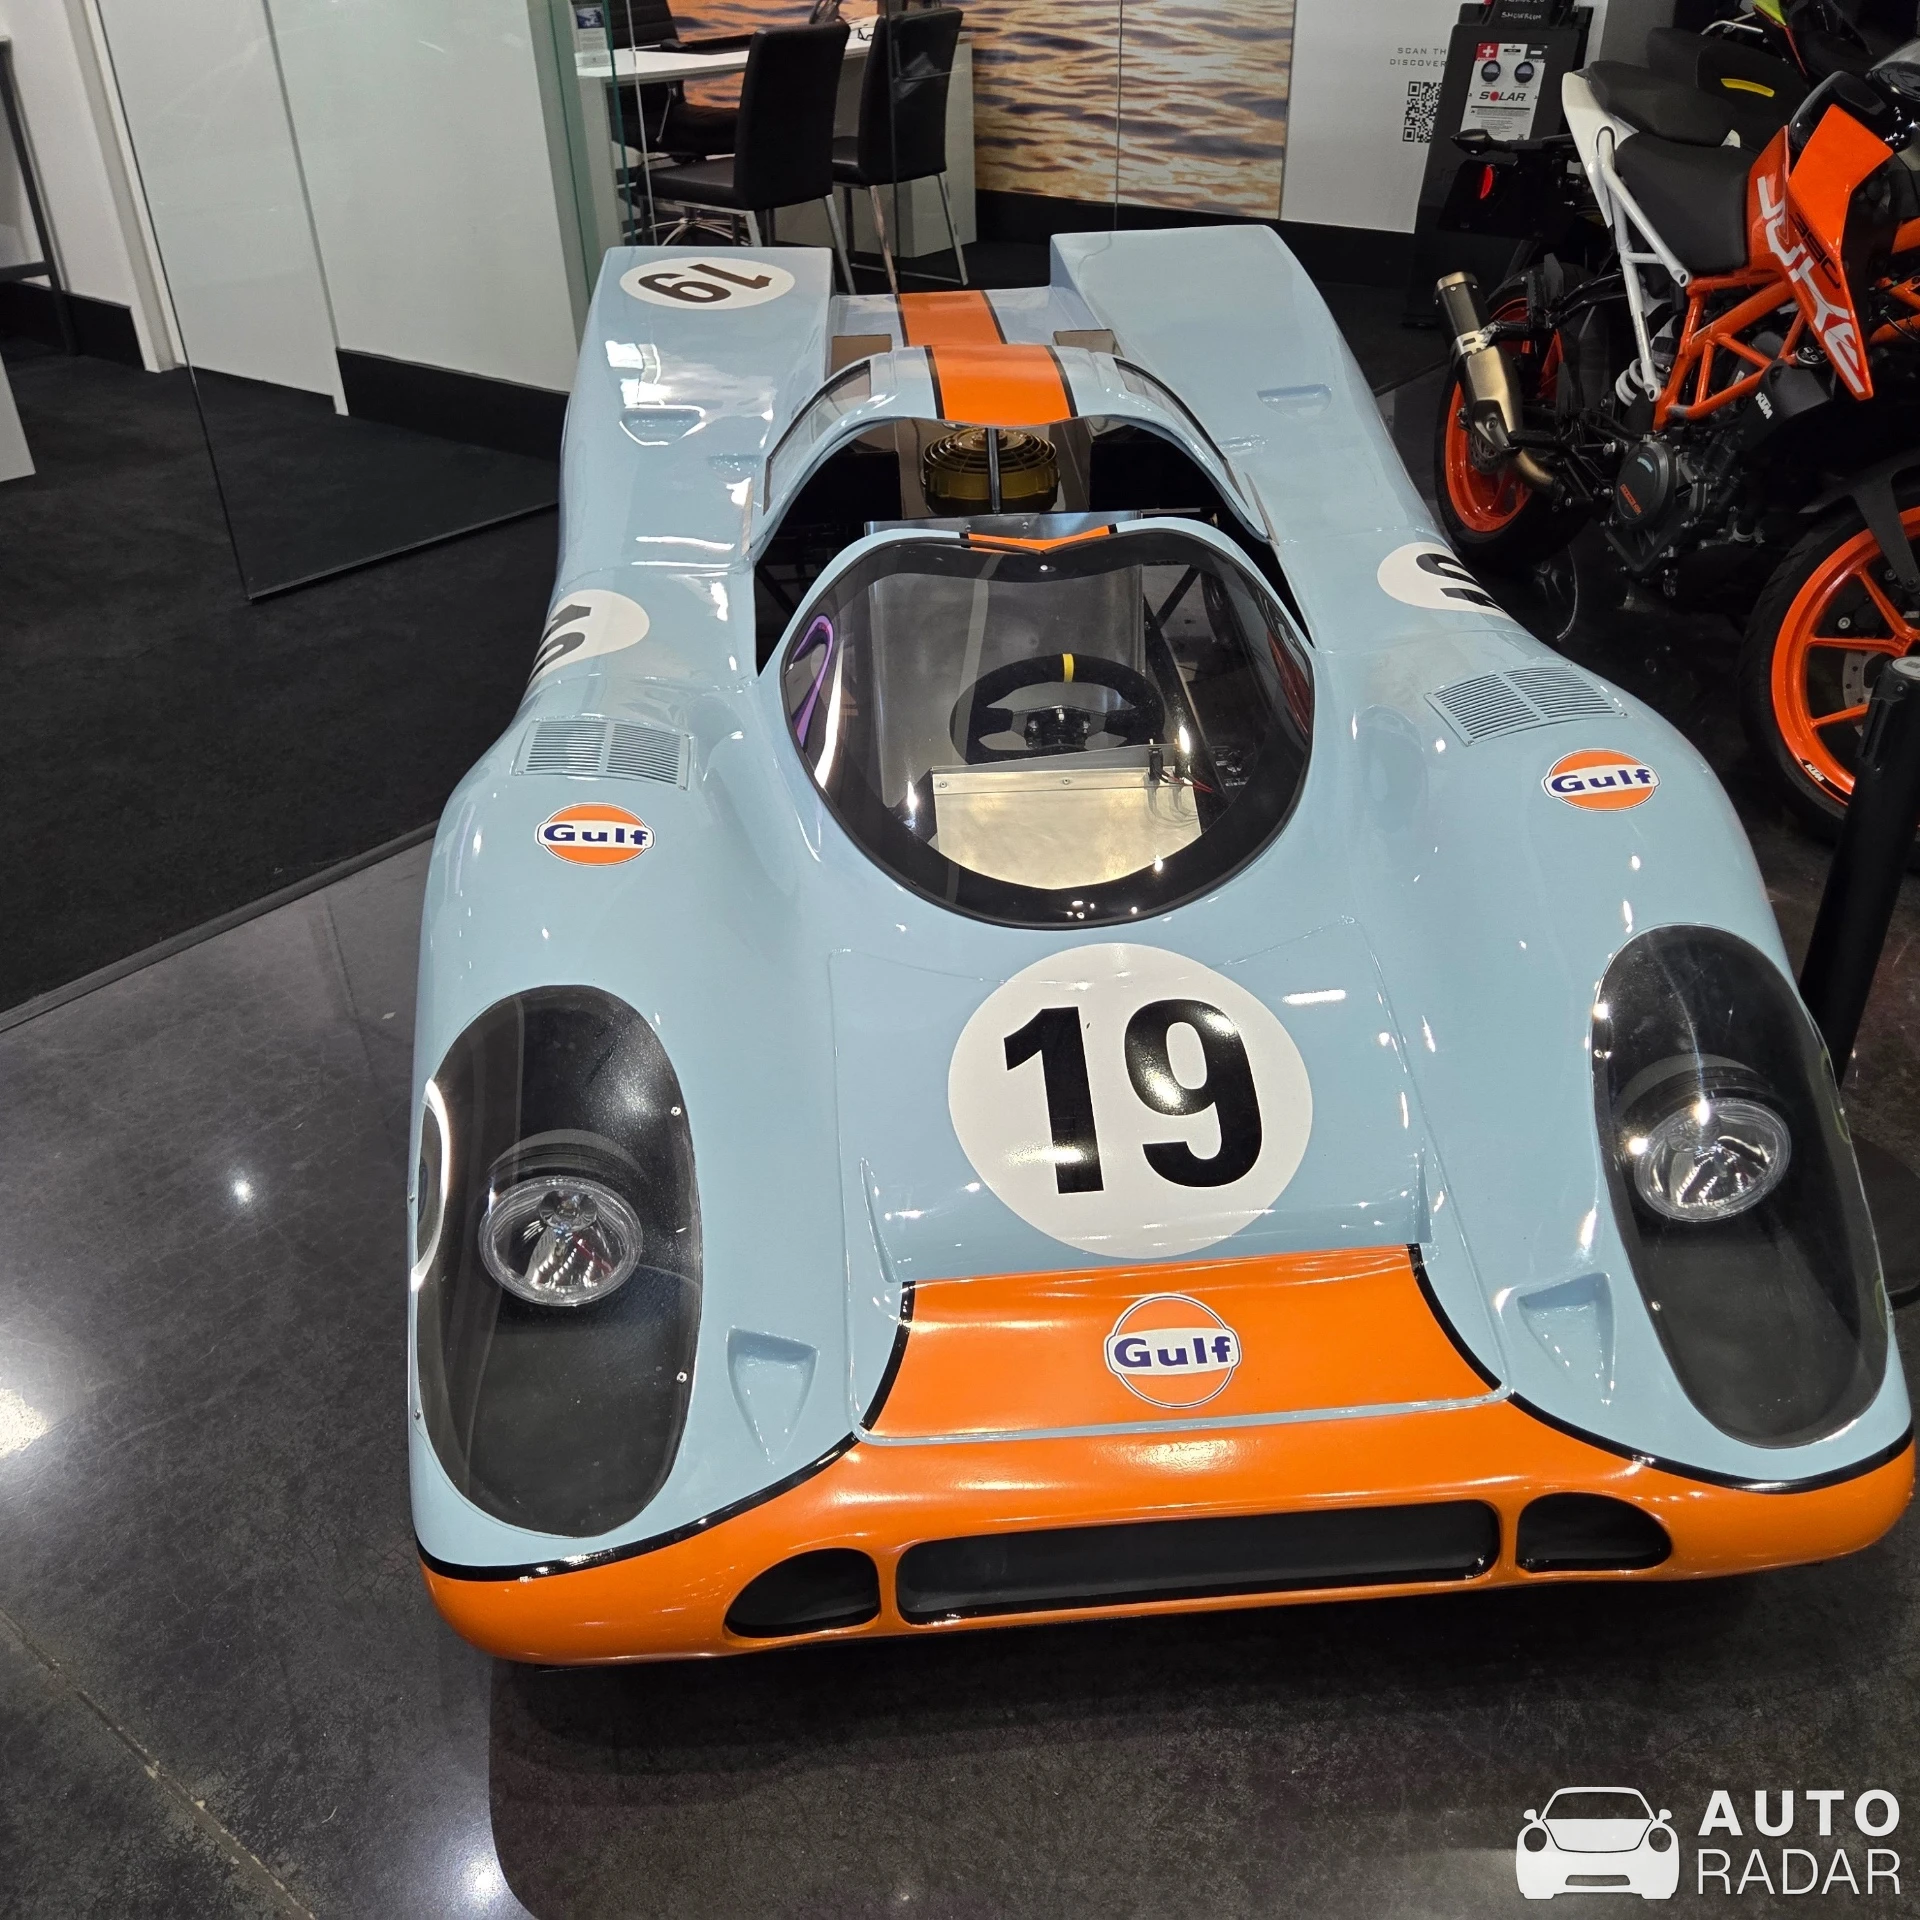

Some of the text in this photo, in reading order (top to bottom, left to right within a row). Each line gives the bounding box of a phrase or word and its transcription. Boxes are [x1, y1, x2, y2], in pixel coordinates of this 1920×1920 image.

[1397, 47, 1427, 55] SCAN
[1789, 210, 1841, 289] 390
[638, 263, 773, 303] 19
[1757, 176, 1866, 393] DUKE
[1755, 391, 1773, 419] KTM
[1551, 768, 1651, 793] Gulf
[1805, 763, 1825, 782] KTM
[543, 824, 648, 846] Gulf
[1003, 998, 1263, 1195] 19
[1113, 1335, 1234, 1368] Gulf
